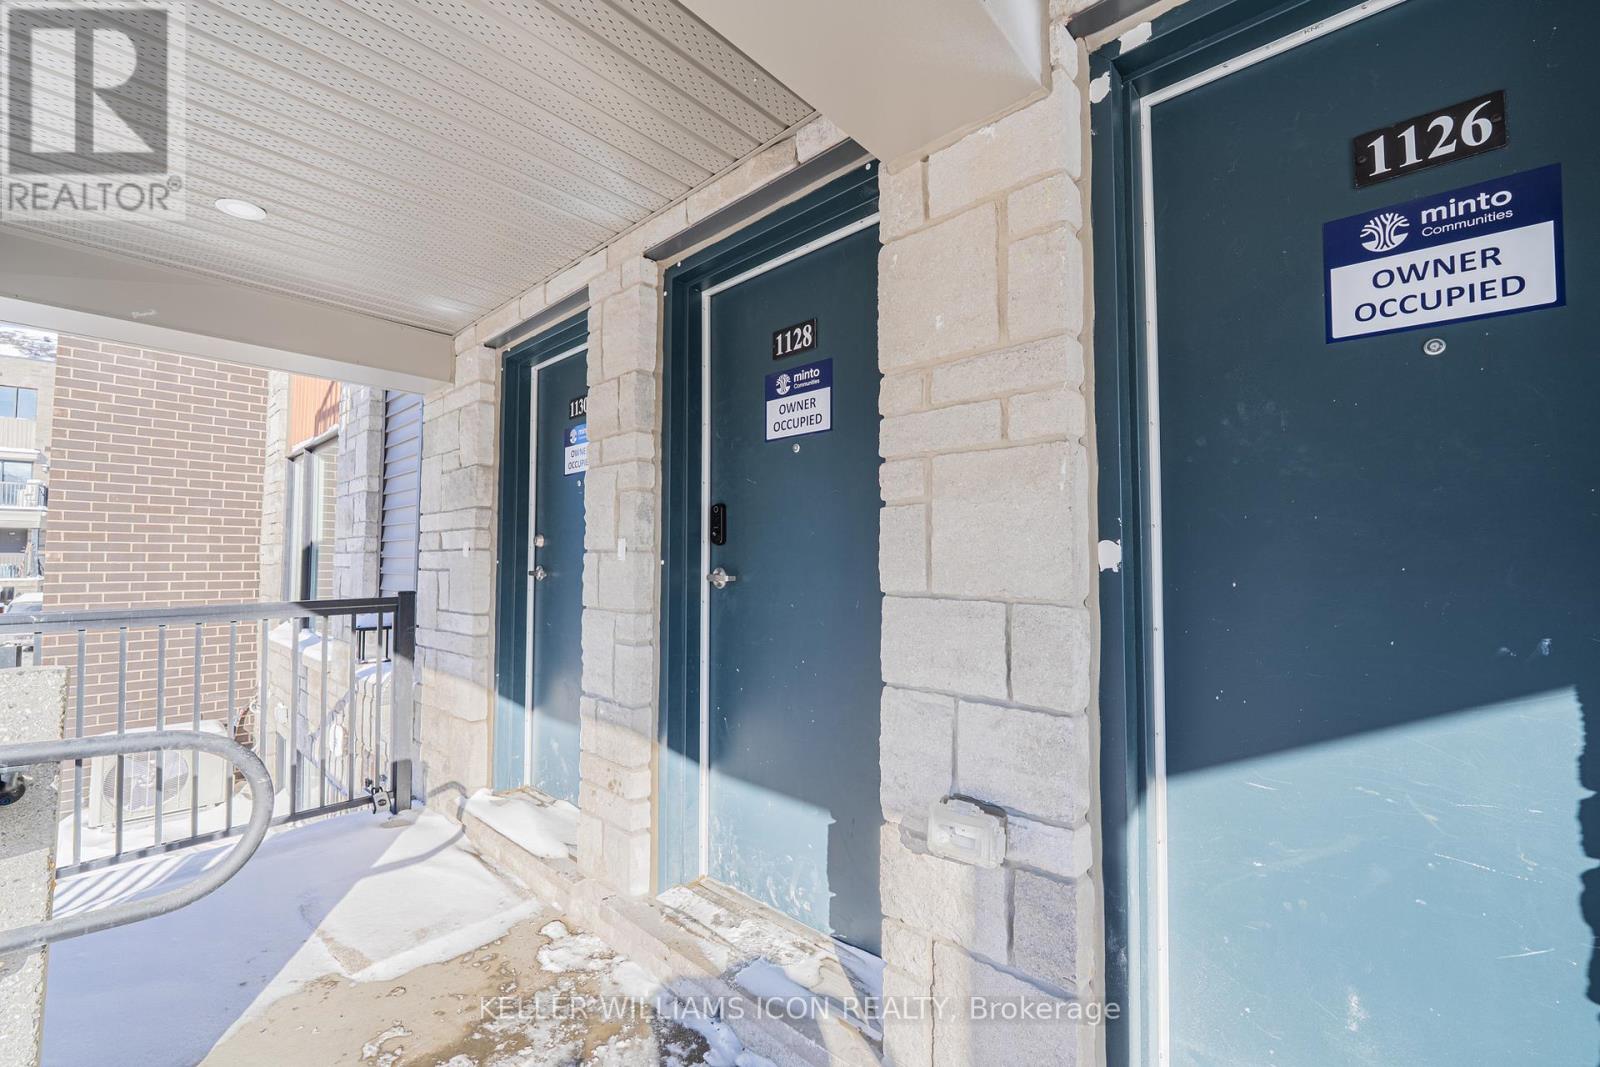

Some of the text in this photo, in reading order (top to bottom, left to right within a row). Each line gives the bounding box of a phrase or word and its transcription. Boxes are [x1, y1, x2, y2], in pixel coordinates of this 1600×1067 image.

[1367, 100, 1493, 177] 1126
[1421, 190, 1513, 224] minto
[1421, 208, 1514, 237] Communities
[1372, 247, 1502, 289] OWNER
[1354, 275, 1526, 322] OCCUPIED
[775, 324, 812, 356] 1128
[793, 368, 820, 382] minto
[793, 378, 820, 389] Communities
[778, 397, 816, 415] OWNER
[773, 413, 822, 432] OCCUPIED
